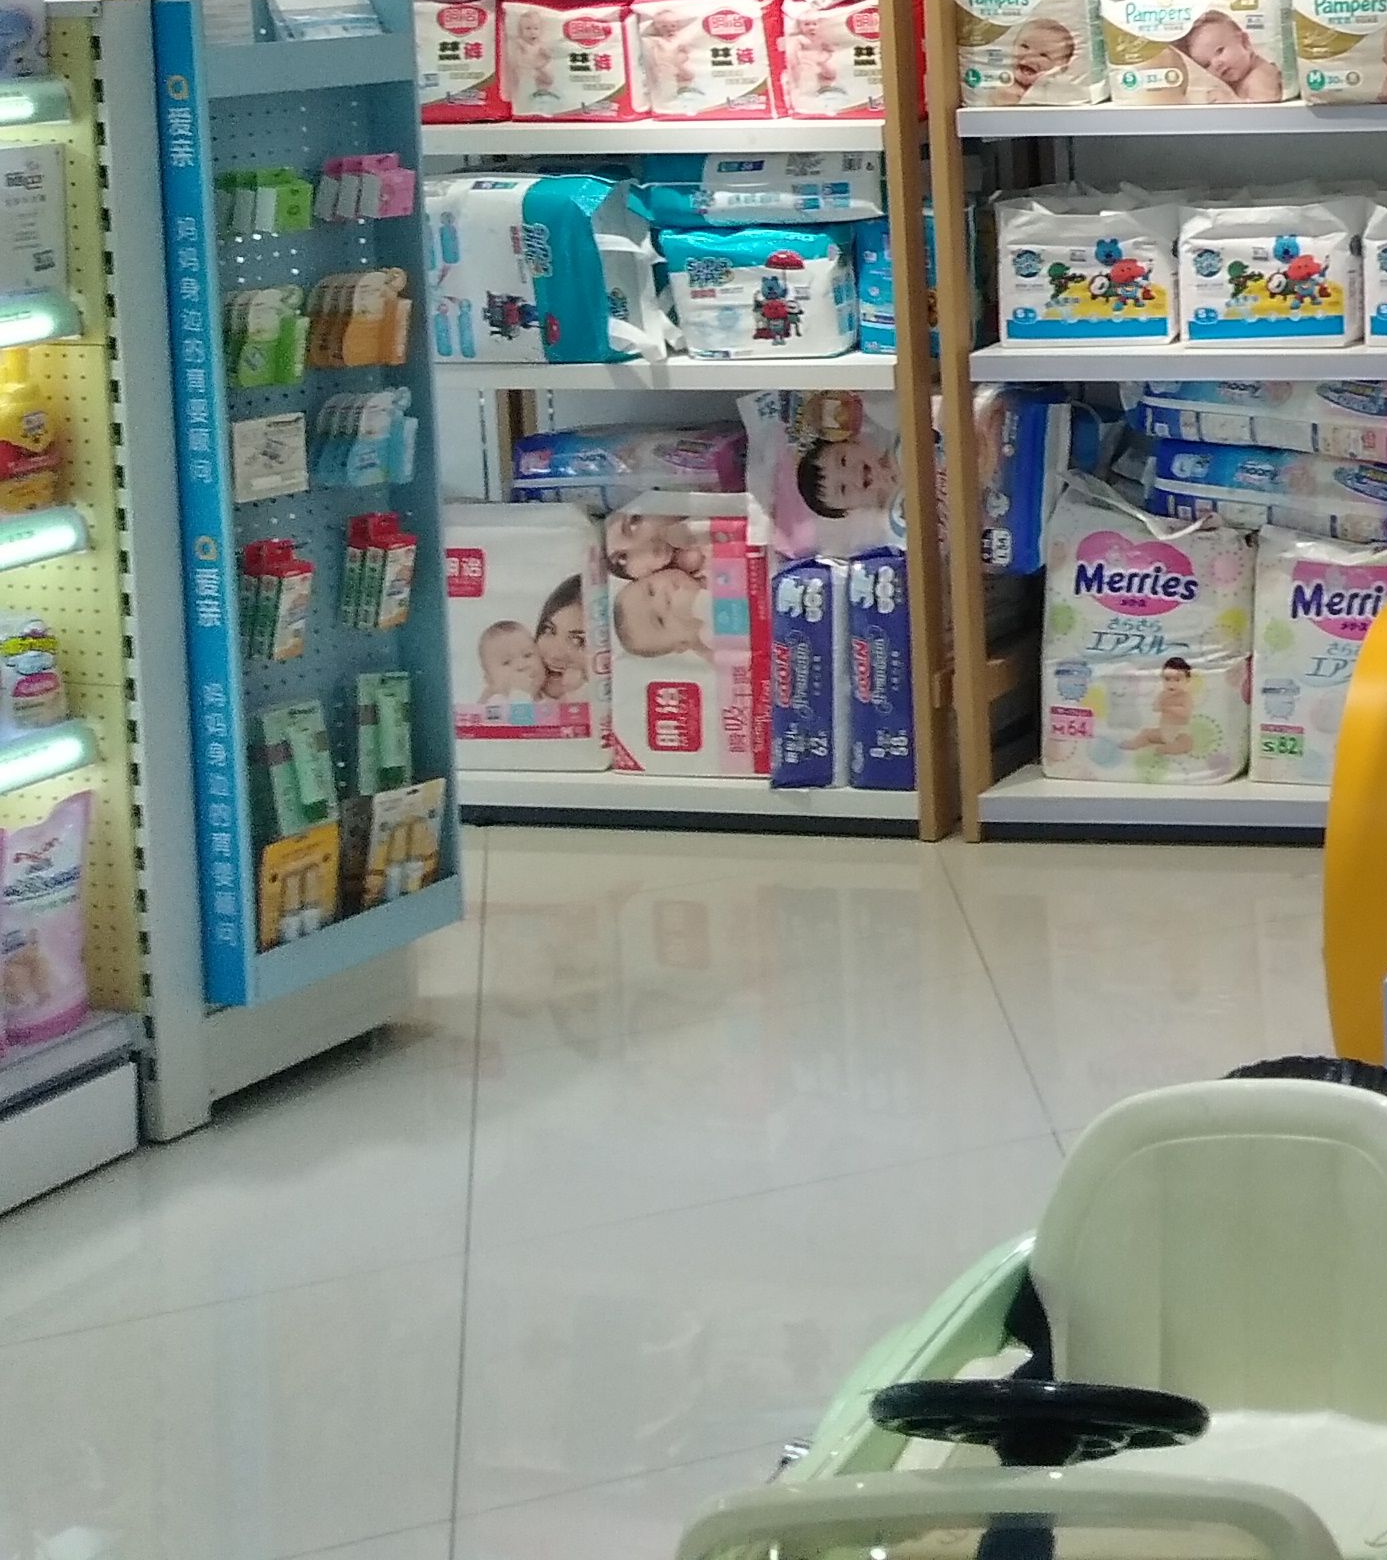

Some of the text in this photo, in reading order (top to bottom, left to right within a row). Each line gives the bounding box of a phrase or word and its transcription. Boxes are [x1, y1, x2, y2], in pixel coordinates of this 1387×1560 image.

[1126, 2, 1192, 26] Pampers
[1075, 564, 1199, 600] Merries
[1291, 583, 1384, 618] Merri
